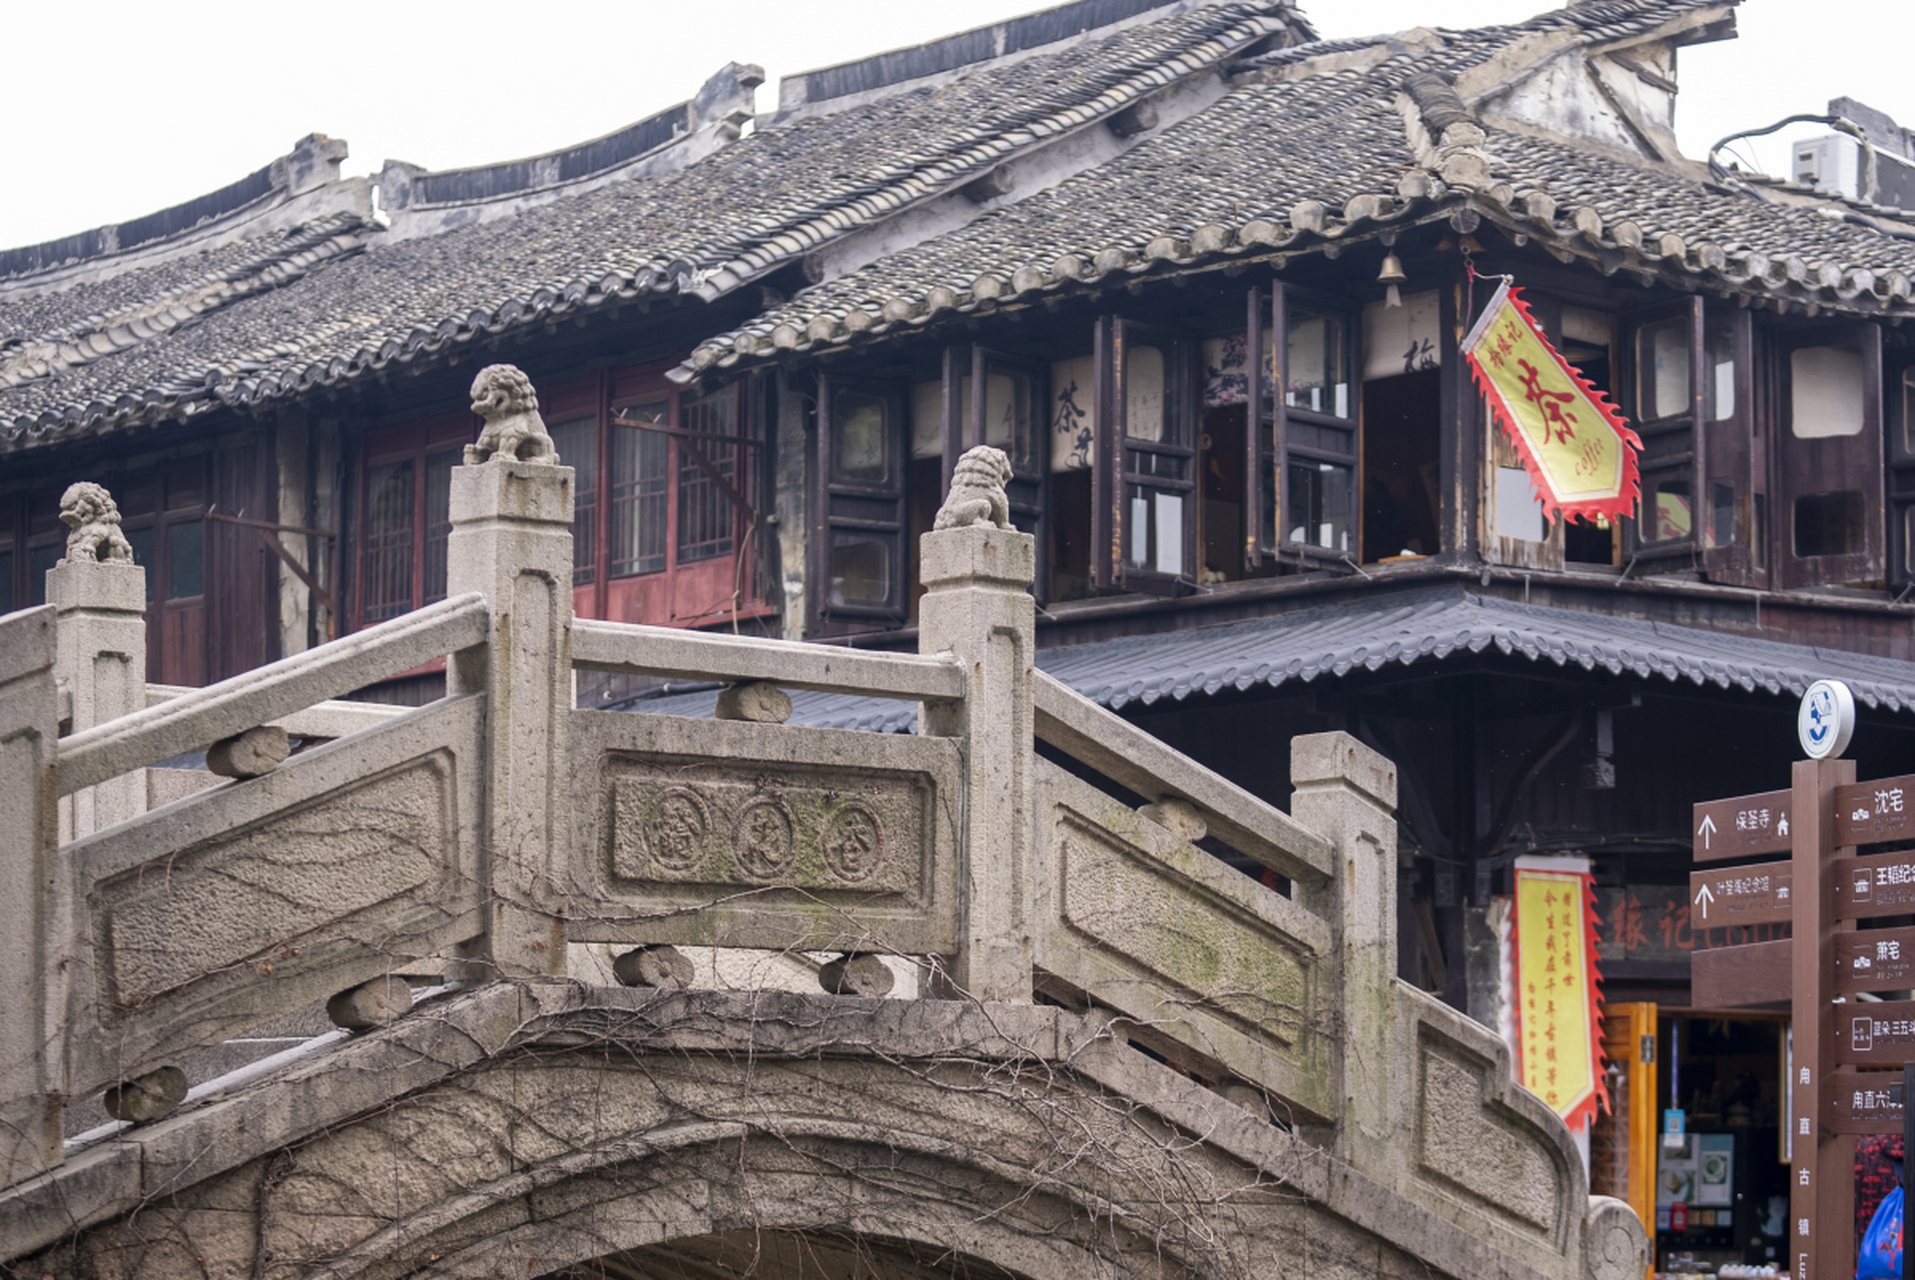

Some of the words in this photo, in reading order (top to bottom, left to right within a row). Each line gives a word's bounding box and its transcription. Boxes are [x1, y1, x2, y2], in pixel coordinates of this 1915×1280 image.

[1517, 357, 1577, 445] 茶
[1574, 437, 1605, 477] coffee
[1874, 786, 1904, 815] 沈宅
[1799, 1066, 1811, 1236] 甪直古镇
